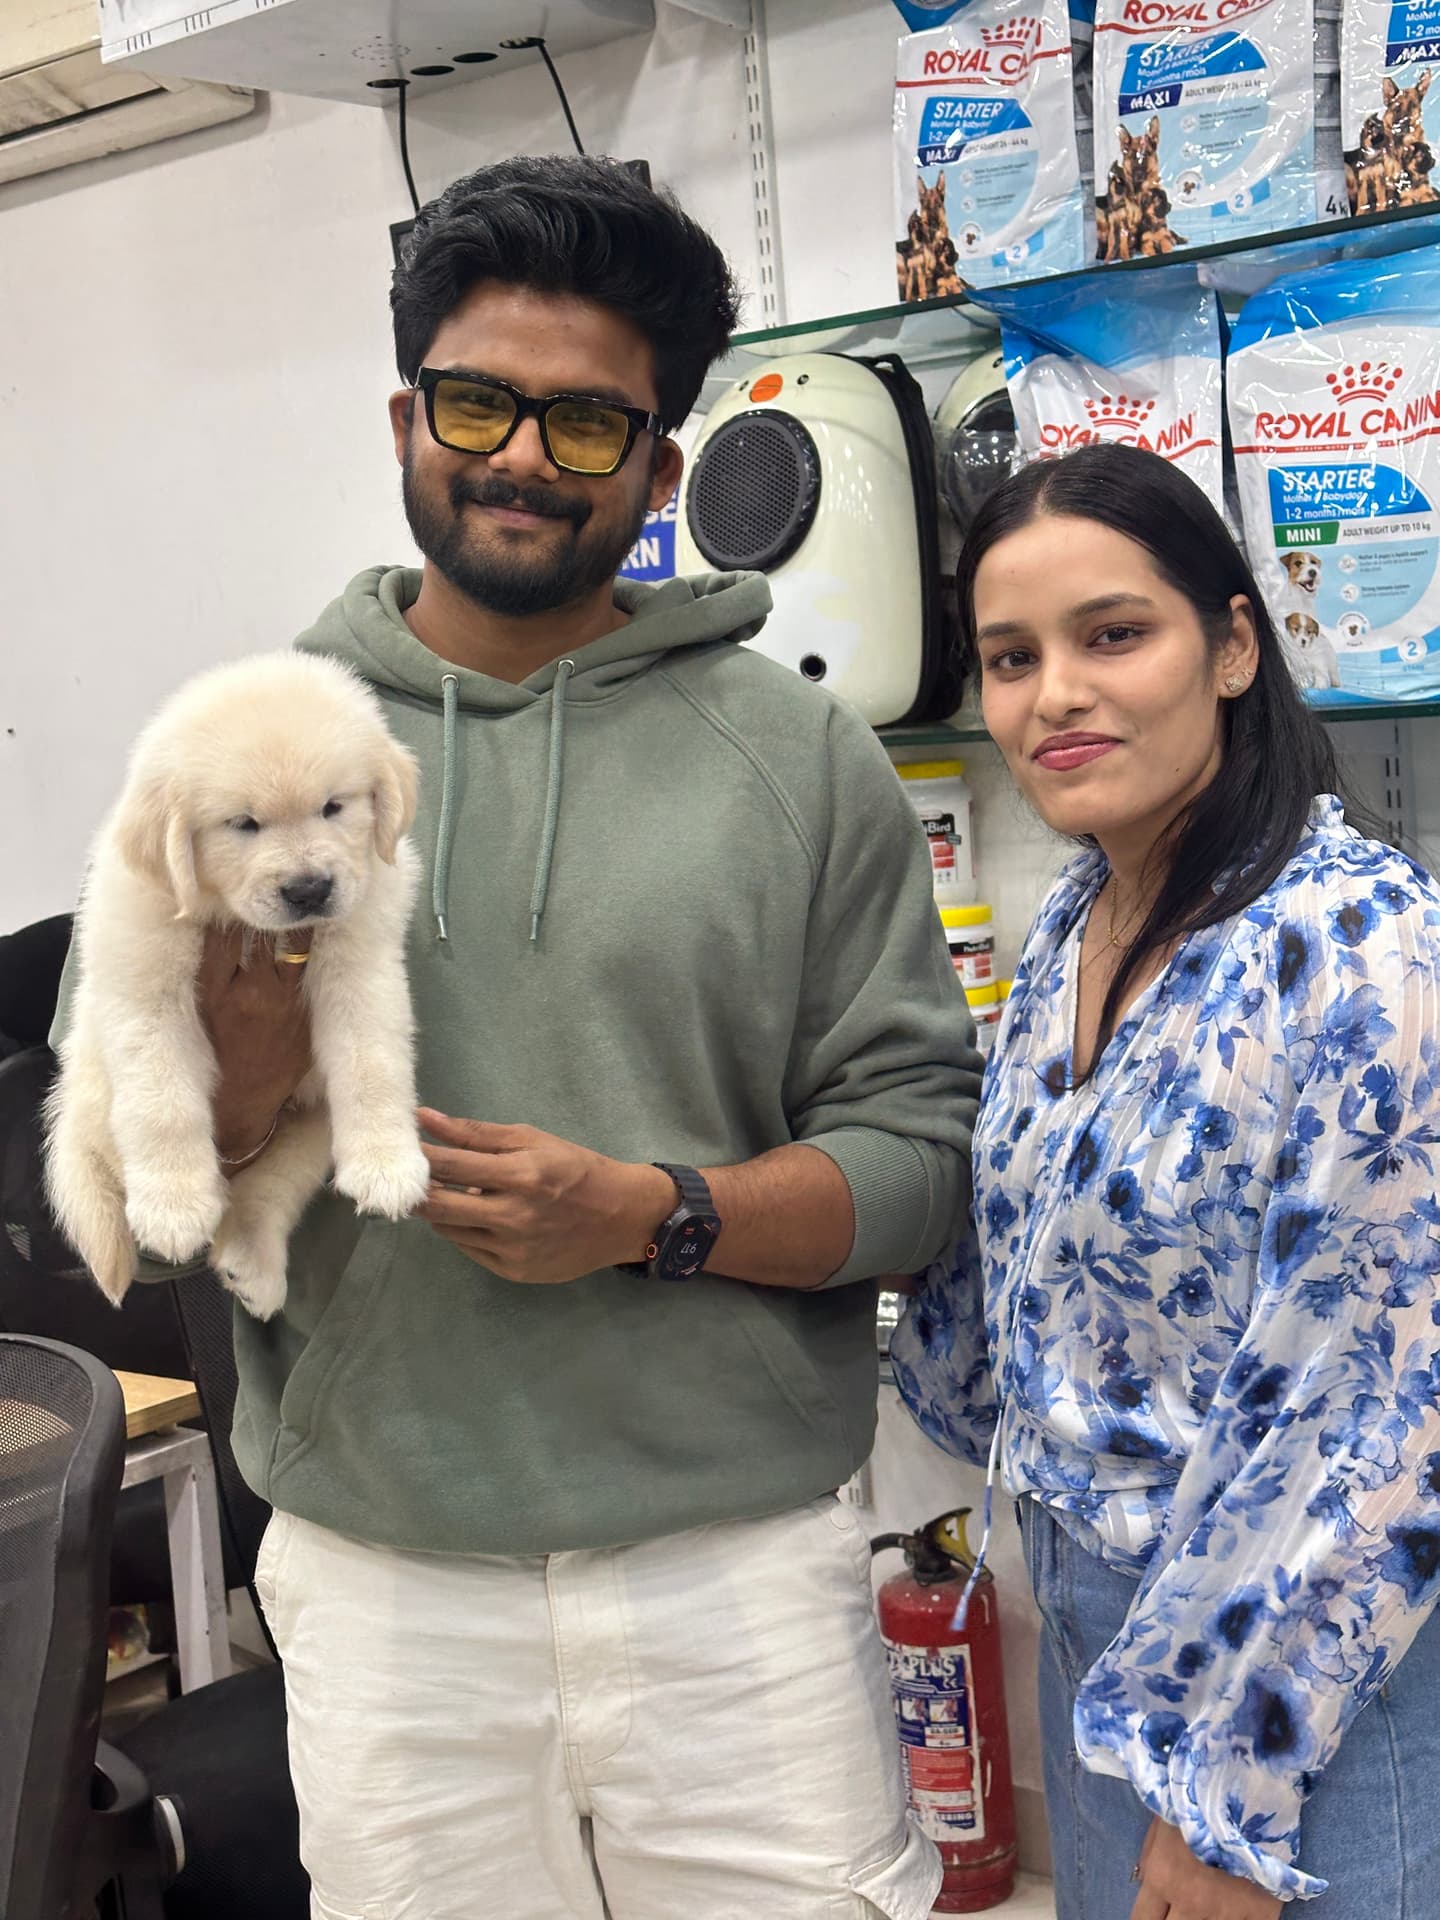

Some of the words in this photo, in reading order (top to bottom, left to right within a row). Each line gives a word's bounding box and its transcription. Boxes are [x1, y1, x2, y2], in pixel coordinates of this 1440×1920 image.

[1123, 0, 1208, 24] ROYAL
[1406, 24, 1424, 38] 1-2
[924, 49, 992, 74] ROYAL
[1130, 90, 1169, 110] MAXI
[933, 101, 1004, 119] STARTER
[926, 149, 957, 162] MAXI
[1234, 193, 1245, 209] 2
[1325, 194, 1337, 215] 4
[1012, 246, 1021, 259] 2
[1255, 411, 1351, 440] ROYAL
[1361, 390, 1440, 435] CANIN
[1040, 422, 1100, 449] OYAL
[1283, 468, 1372, 492] STARTER
[1285, 507, 1302, 520] 1-2
[1287, 528, 1321, 543] MINI
[1343, 528, 1362, 537] ADULT
[1364, 525, 1388, 535] WEIGHT
[1390, 524, 1400, 533] UP
[1401, 523, 1411, 532] TO
[1407, 641, 1417, 656] 2
[922, 821, 951, 833] Bird
